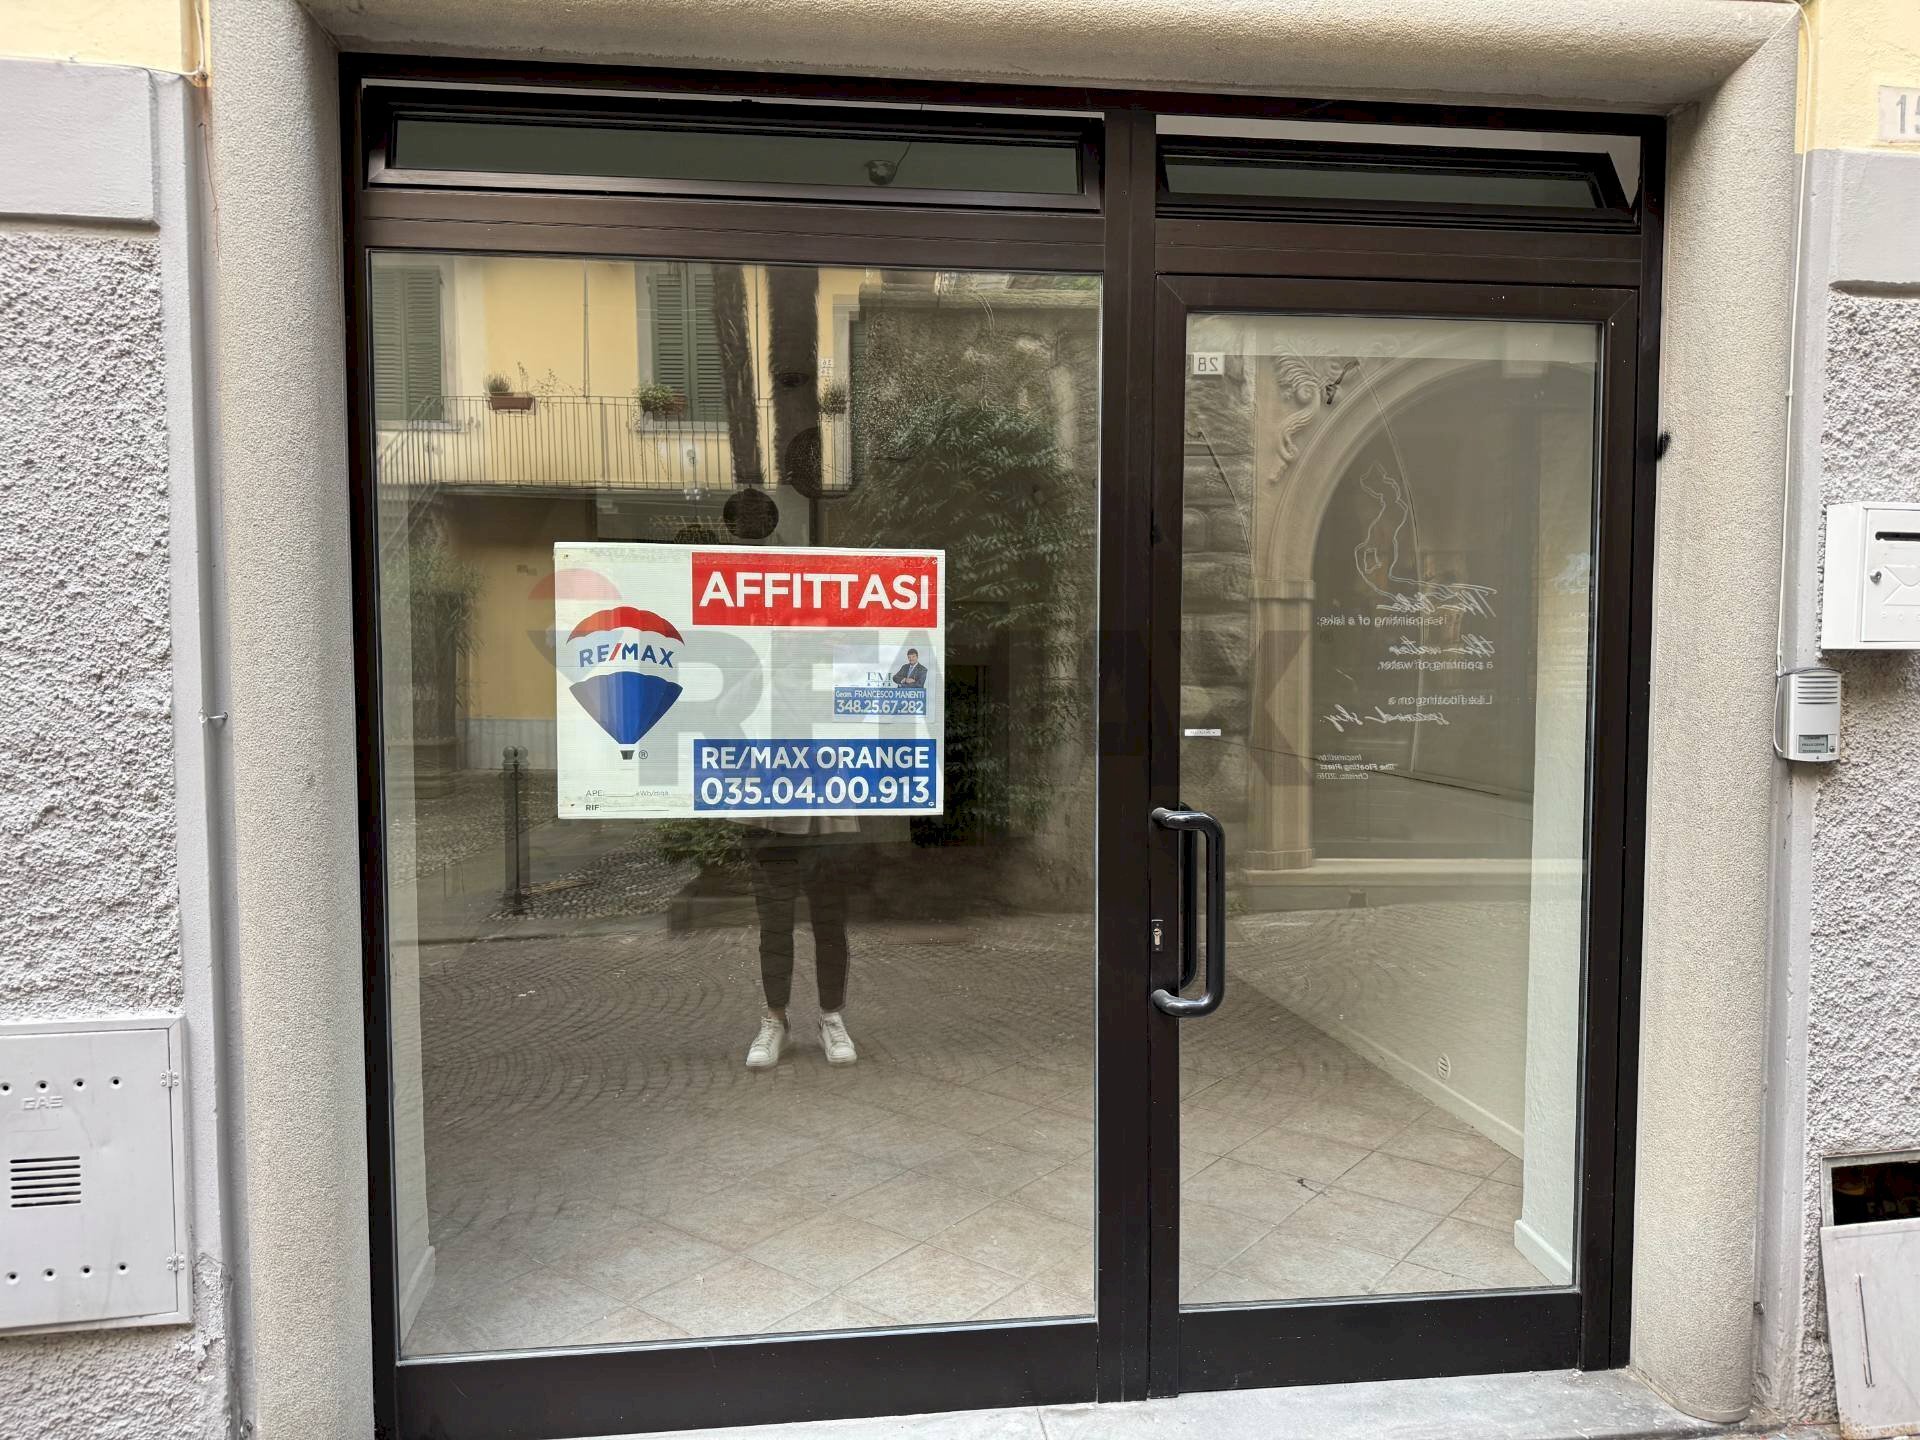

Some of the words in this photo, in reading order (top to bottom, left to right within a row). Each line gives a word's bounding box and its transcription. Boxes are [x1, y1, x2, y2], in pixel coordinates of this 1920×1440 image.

[700, 571, 929, 610] AFFITTASI
[578, 642, 674, 668] RE/MAX
[854, 690, 894, 699] FRANCESCO
[895, 690, 925, 699] MANENTI
[836, 700, 924, 714] 348.25.67.282
[702, 746, 809, 770] RE/MAX
[816, 746, 930, 770] ORANGE
[700, 776, 930, 806] 035.04.00.913
[21, 1096, 65, 1110] GAS
